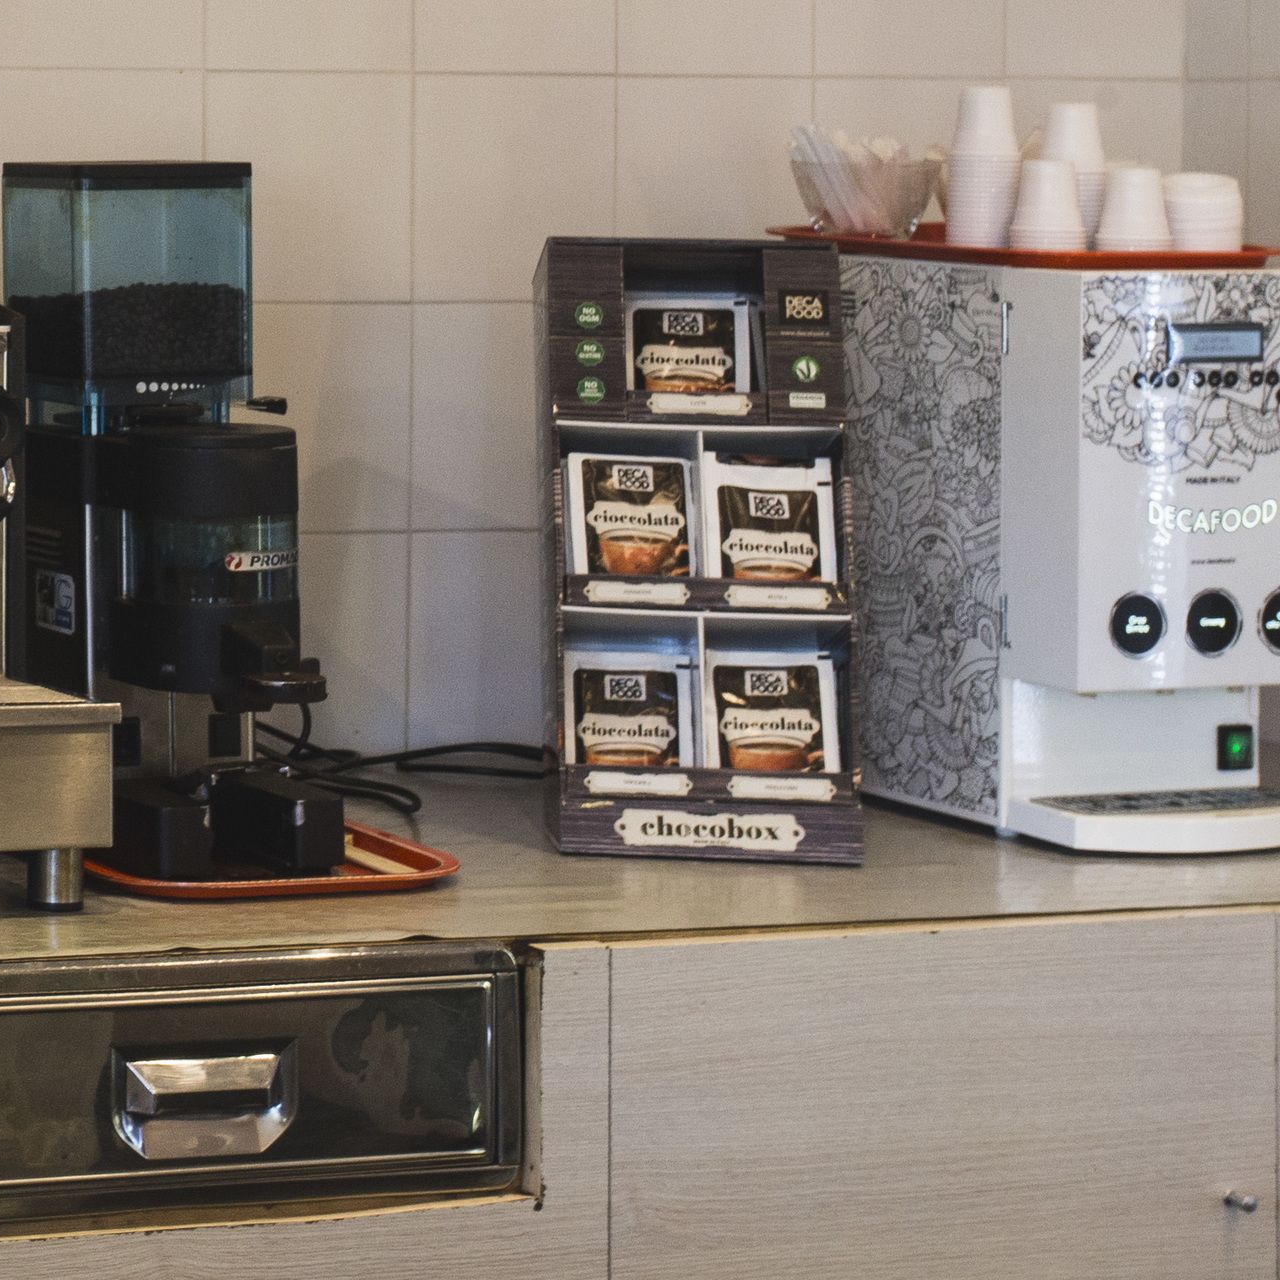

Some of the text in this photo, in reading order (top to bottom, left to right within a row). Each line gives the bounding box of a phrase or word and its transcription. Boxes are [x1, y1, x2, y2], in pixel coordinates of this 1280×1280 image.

[785, 296, 822, 309] DECA
[582, 307, 596, 315] NO
[785, 308, 823, 319] FOOD
[583, 344, 597, 352] NO
[640, 352, 727, 367] cioccolata
[584, 381, 598, 389] NO
[617, 468, 648, 479] DECA
[617, 477, 650, 490] FOOD
[754, 495, 783, 507] DECA
[593, 509, 680, 527] cioccolata
[754, 505, 786, 518] FOOD
[1148, 498, 1278, 534] DECAFOOD
[729, 538, 815, 557] cioccolata
[609, 678, 640, 689] DECA
[750, 673, 782, 684] DECA
[723, 715, 814, 732] cioccolata
[581, 722, 670, 739] cioccolata
[640, 814, 781, 841] chocobox
